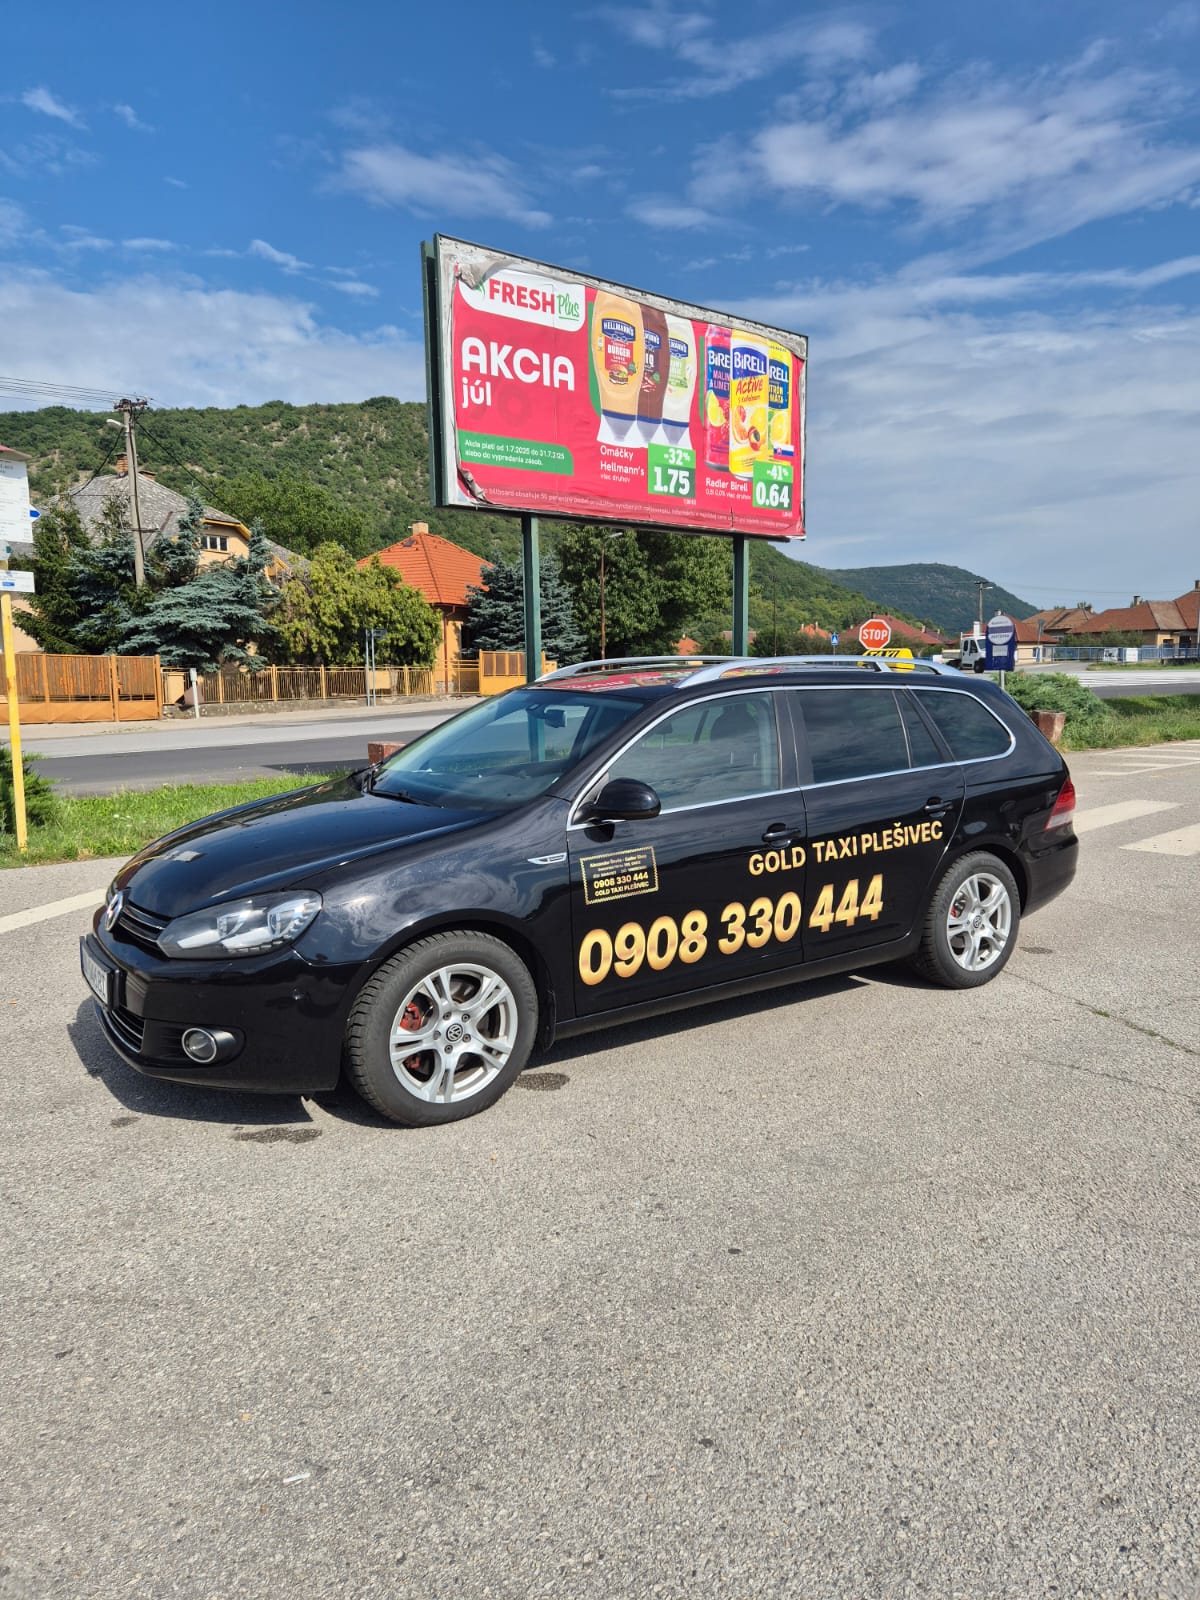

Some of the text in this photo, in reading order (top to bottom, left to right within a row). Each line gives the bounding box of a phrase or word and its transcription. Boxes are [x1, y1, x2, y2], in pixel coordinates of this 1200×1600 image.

[488, 278, 581, 321] FRESH Plus
[603, 320, 635, 337] HELLMANN'S
[461, 336, 575, 391] AKCIA
[461, 376, 492, 409] júl
[464, 439, 481, 449] Akcia
[496, 444, 505, 452] od
[505, 445, 531, 456] 1.7.2025
[530, 449, 539, 457] do
[600, 445, 634, 463] Omáčky
[663, 447, 691, 466] -32%
[600, 461, 645, 477] Hellmann's
[653, 466, 691, 496] 1.75
[705, 477, 749, 493] Radler Birell
[755, 481, 791, 509] 0.64
[862, 629, 889, 641] STOP
[749, 820, 944, 876] GOLD TAXI PLEŠIVEC
[594, 877, 615, 889] 0908
[616, 874, 632, 884] 330
[633, 871, 649, 881] 444
[594, 880, 650, 897] GOLD TAXI PLEŠIVEC
[578, 873, 884, 987] 0908 330 444
